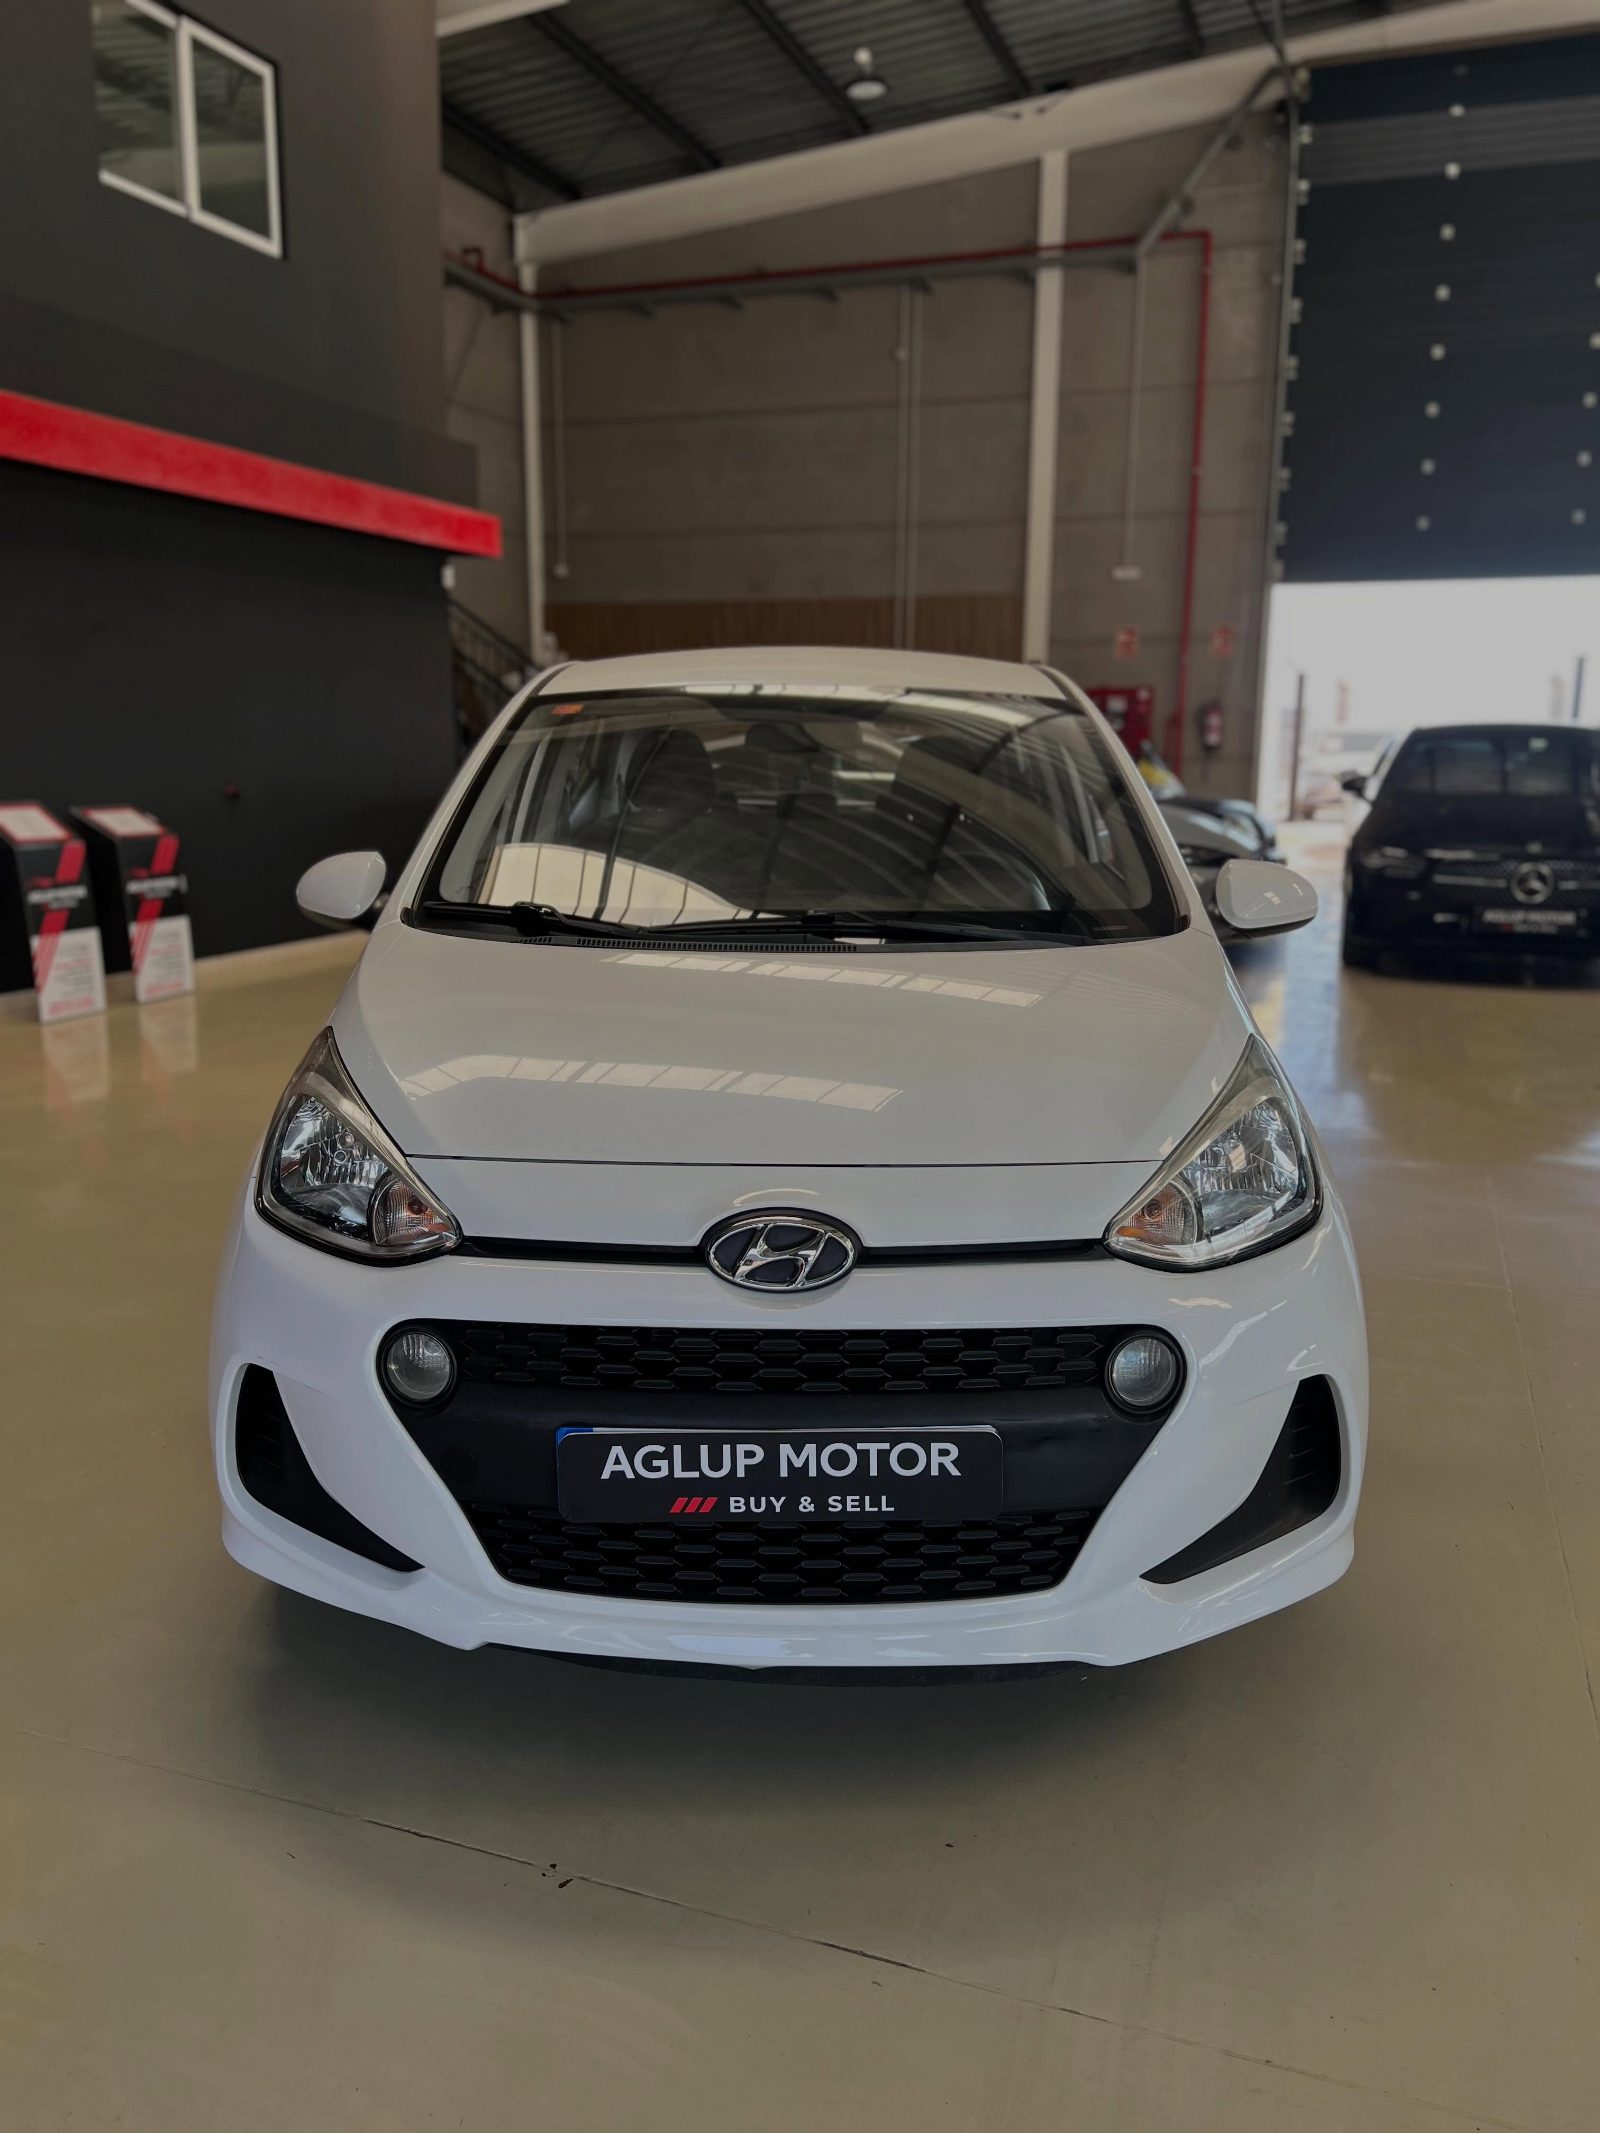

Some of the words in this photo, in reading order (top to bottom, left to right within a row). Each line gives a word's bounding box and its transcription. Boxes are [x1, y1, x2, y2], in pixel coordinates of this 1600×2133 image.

[600, 1443, 765, 1480] AGLUP
[779, 1442, 962, 1479] MOTOR
[729, 1496, 787, 1513] BUY
[798, 1495, 815, 1513] &
[827, 1494, 895, 1513] SELL
